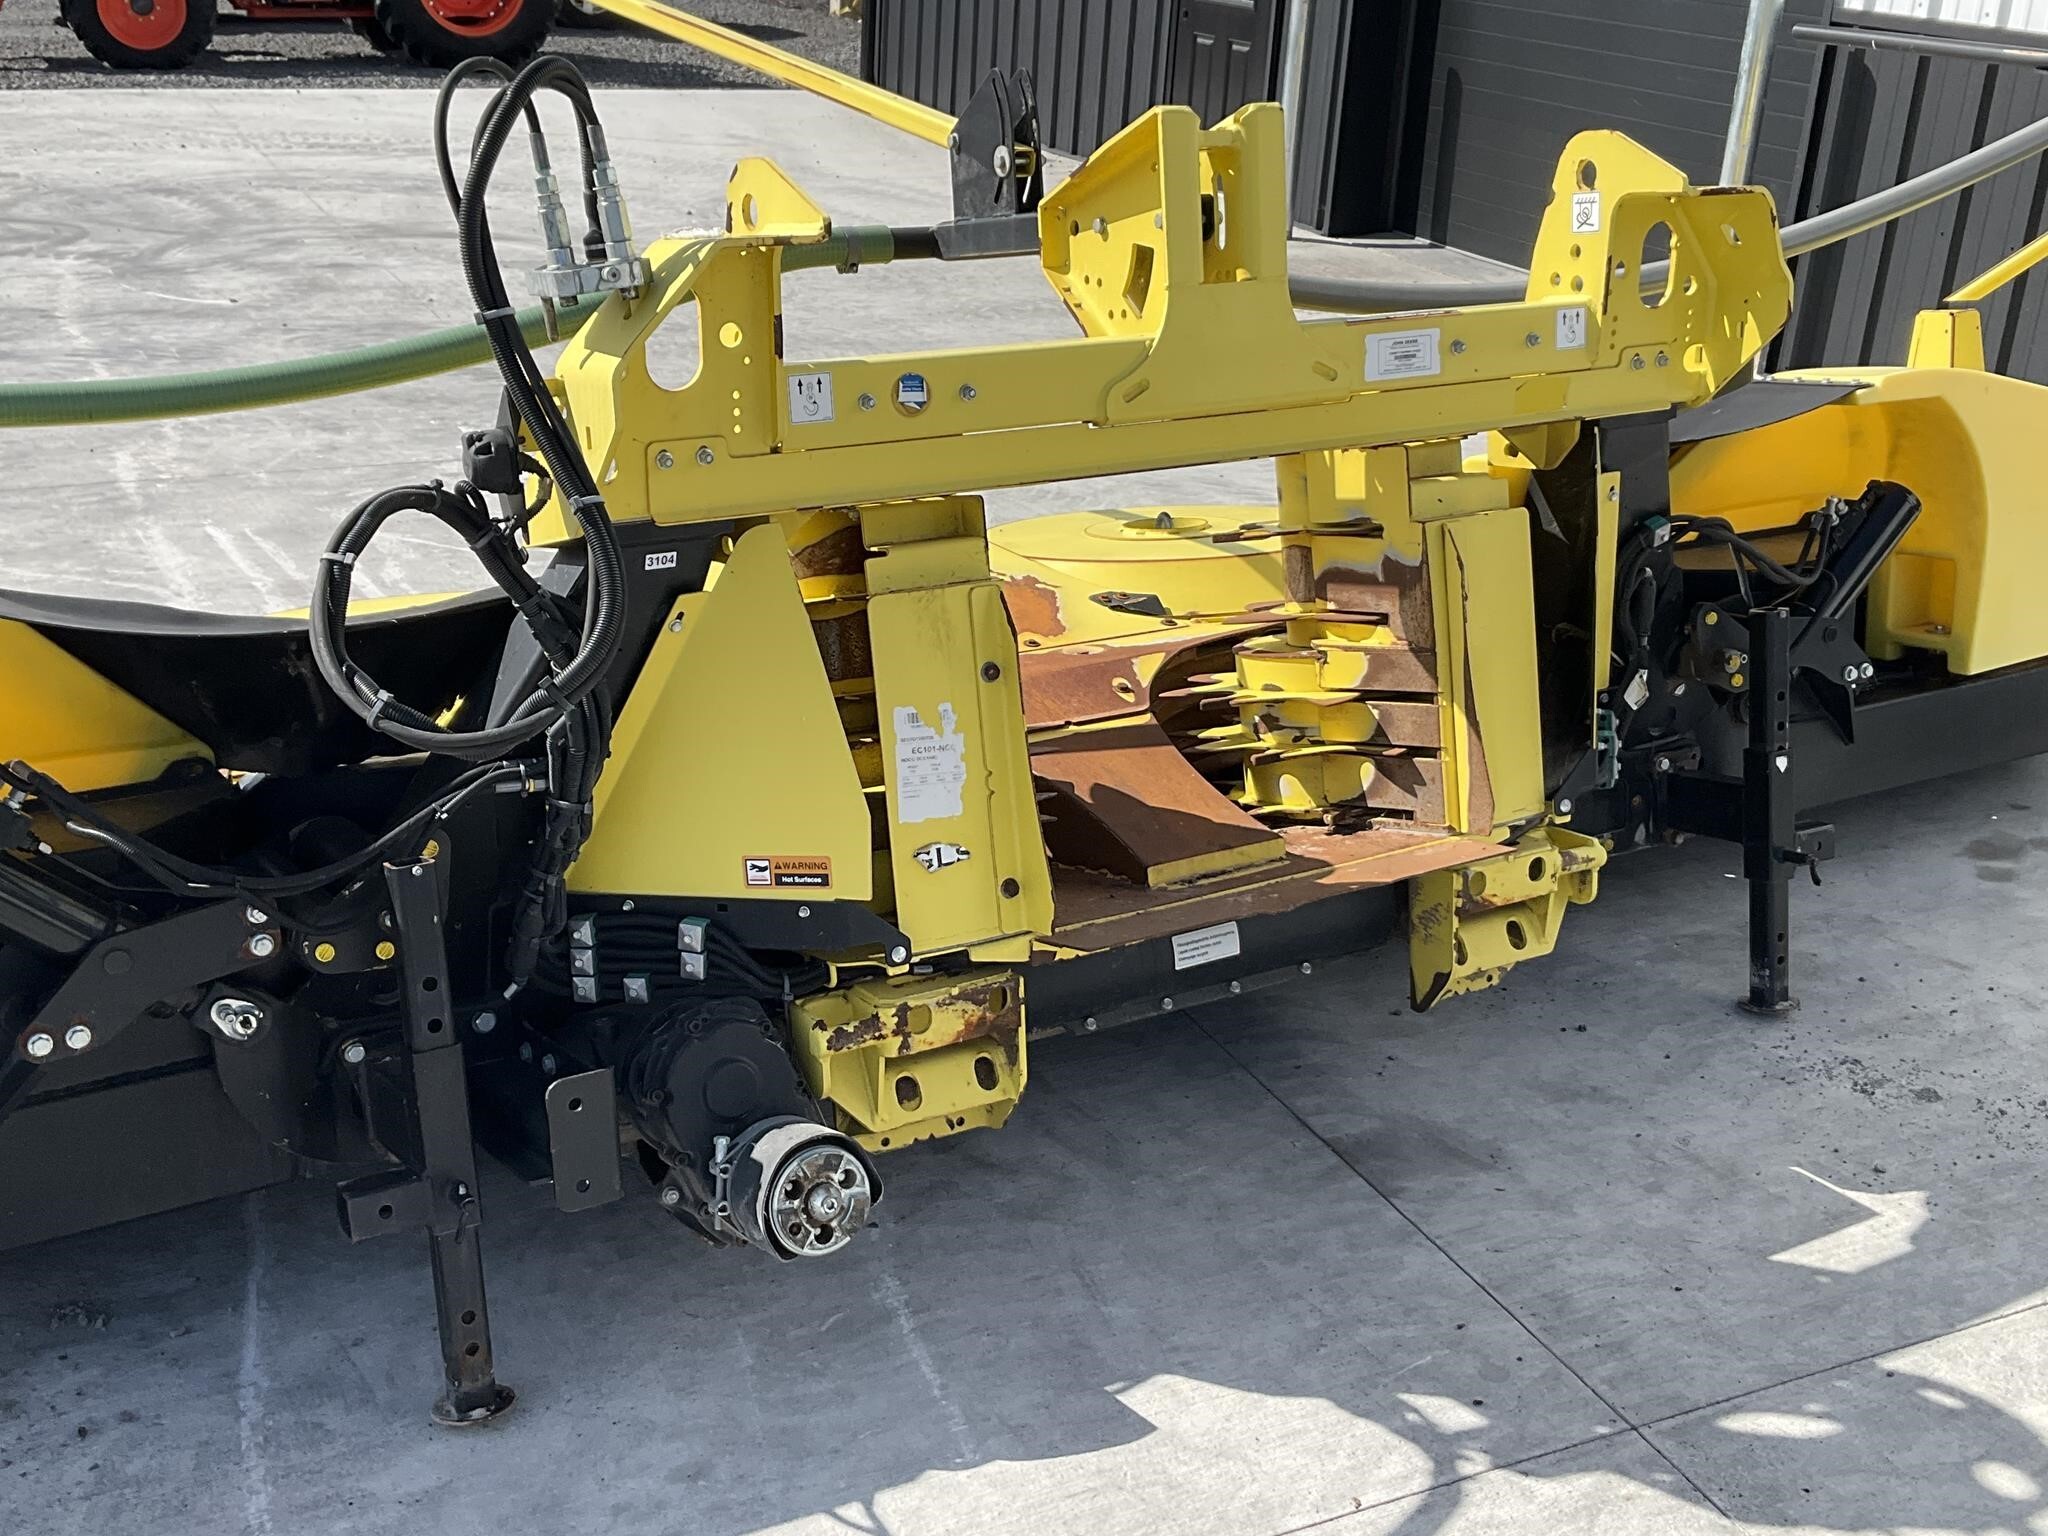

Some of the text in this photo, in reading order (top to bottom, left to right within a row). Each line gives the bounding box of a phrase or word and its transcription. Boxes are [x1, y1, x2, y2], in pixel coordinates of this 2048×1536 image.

[647, 554, 674, 567] 3104
[782, 861, 828, 871] WARNING
[782, 875, 822, 884] Hot Surfaces
